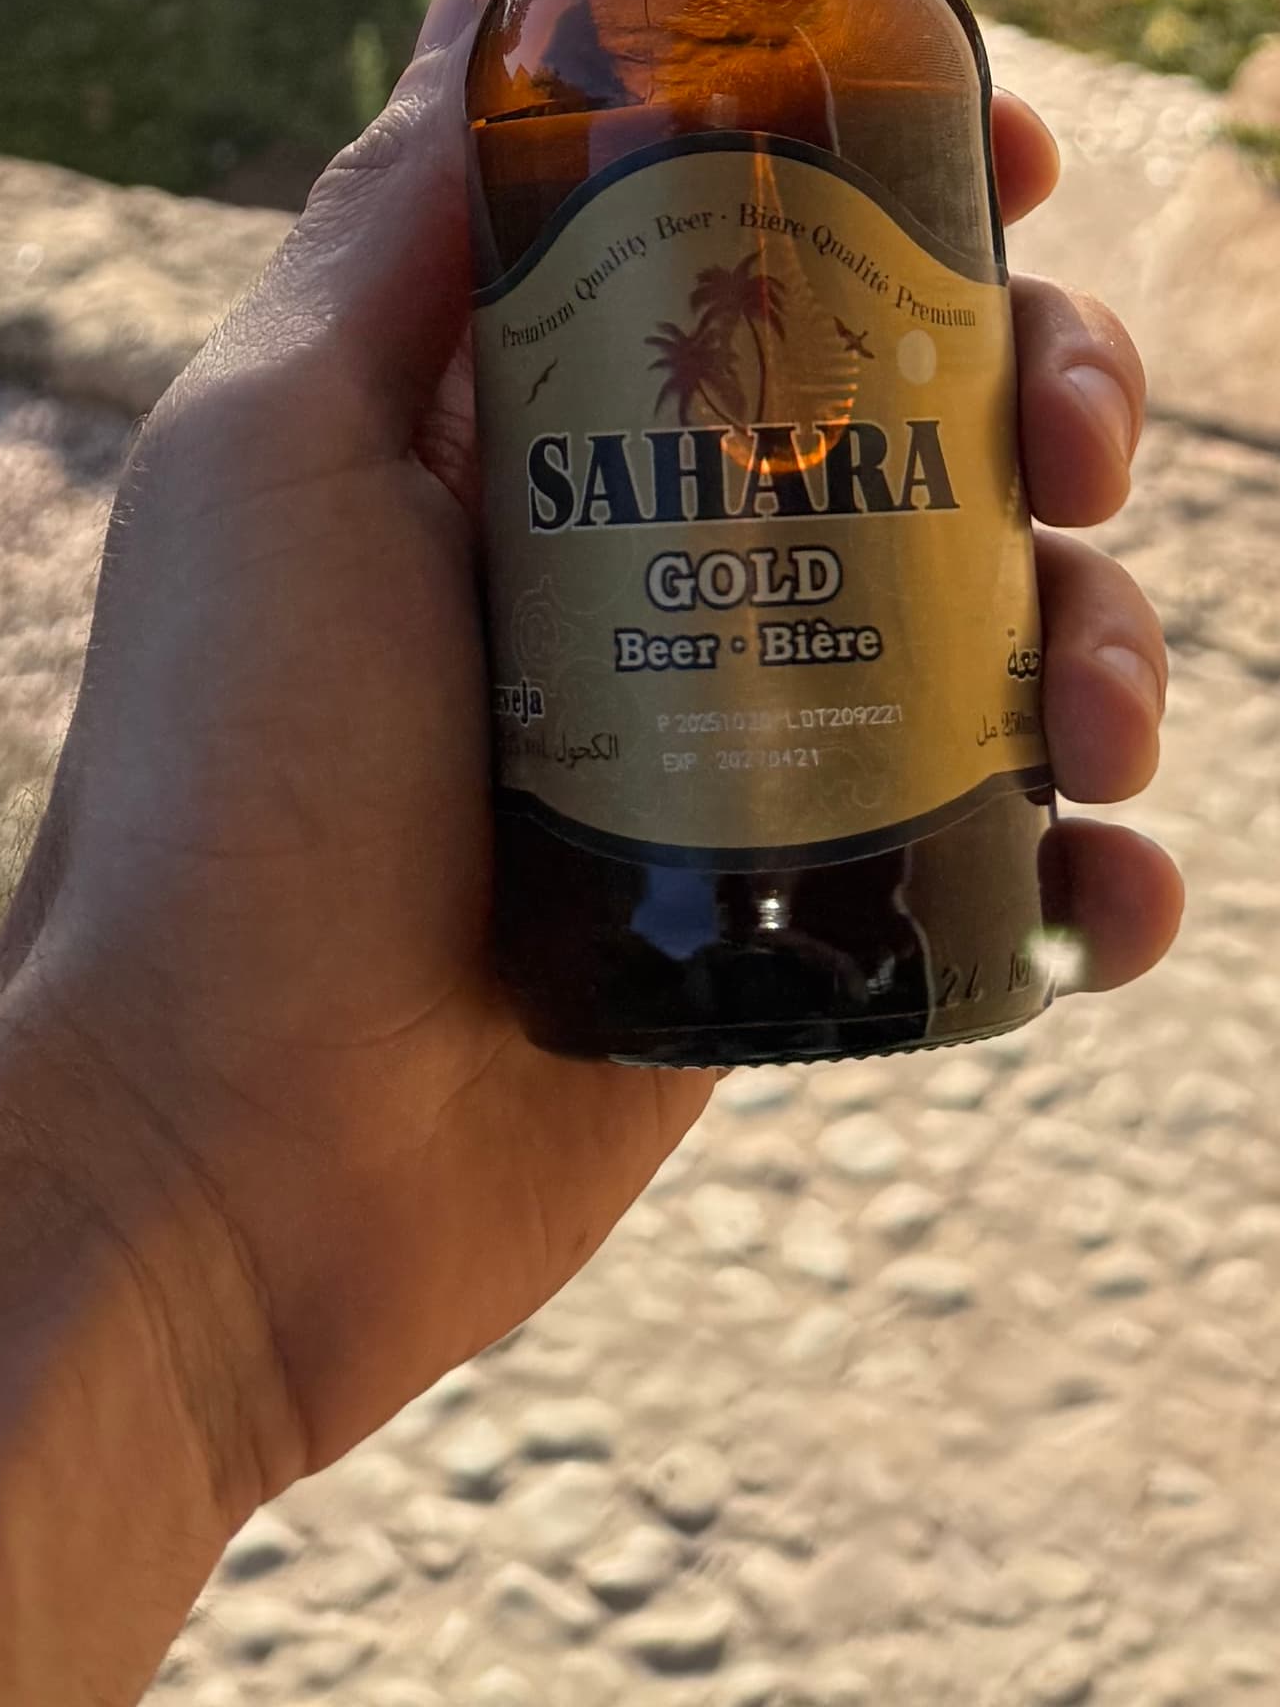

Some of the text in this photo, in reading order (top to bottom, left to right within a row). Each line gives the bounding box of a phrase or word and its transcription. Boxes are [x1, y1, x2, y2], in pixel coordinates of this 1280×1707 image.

[501, 300, 576, 348] Premium
[574, 232, 648, 301] Quality
[654, 210, 713, 240] Beer
[812, 225, 890, 295] Qualité
[895, 283, 977, 328] Premium
[528, 419, 960, 532] SAHARA
[645, 545, 842, 612] GOLD
[615, 618, 883, 671] Beer Bière
